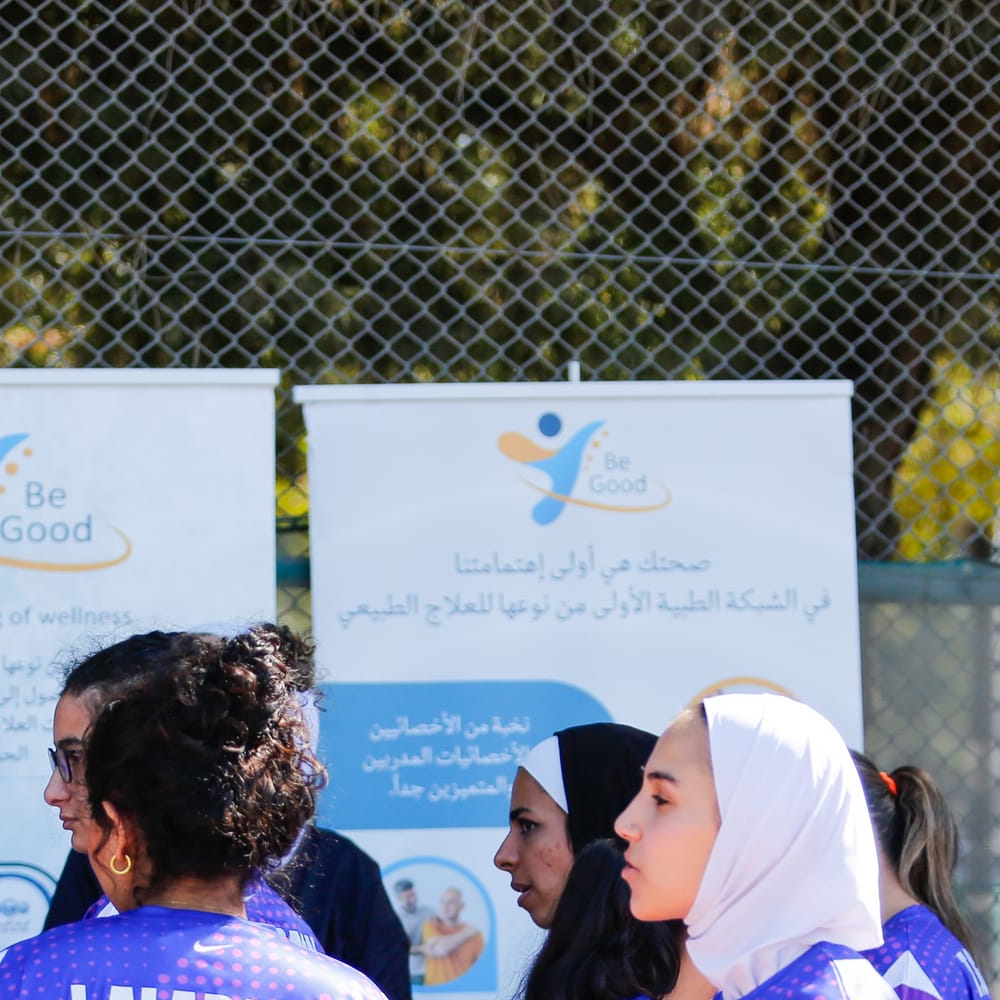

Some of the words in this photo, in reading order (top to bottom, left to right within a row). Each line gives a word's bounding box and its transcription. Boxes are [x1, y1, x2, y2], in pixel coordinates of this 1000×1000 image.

[605, 452, 631, 471] Be
[26, 481, 67, 508] Be
[589, 473, 648, 494] Good
[0, 514, 92, 542] Good
[601, 557, 631, 584] هي
[638, 549, 712, 573] صحتك
[9, 606, 33, 625] of
[37, 607, 133, 625] wellness
[338, 593, 418, 629] الطبيعي
[424, 592, 493, 626] للعلاج
[500, 592, 550, 621] نوعها
[556, 600, 587, 621] من
[657, 589, 720, 618] الطبية
[725, 588, 798, 616] الشبكة
[803, 589, 832, 624] في
[2, 655, 41, 678] نوعها
[464, 721, 489, 740] من
